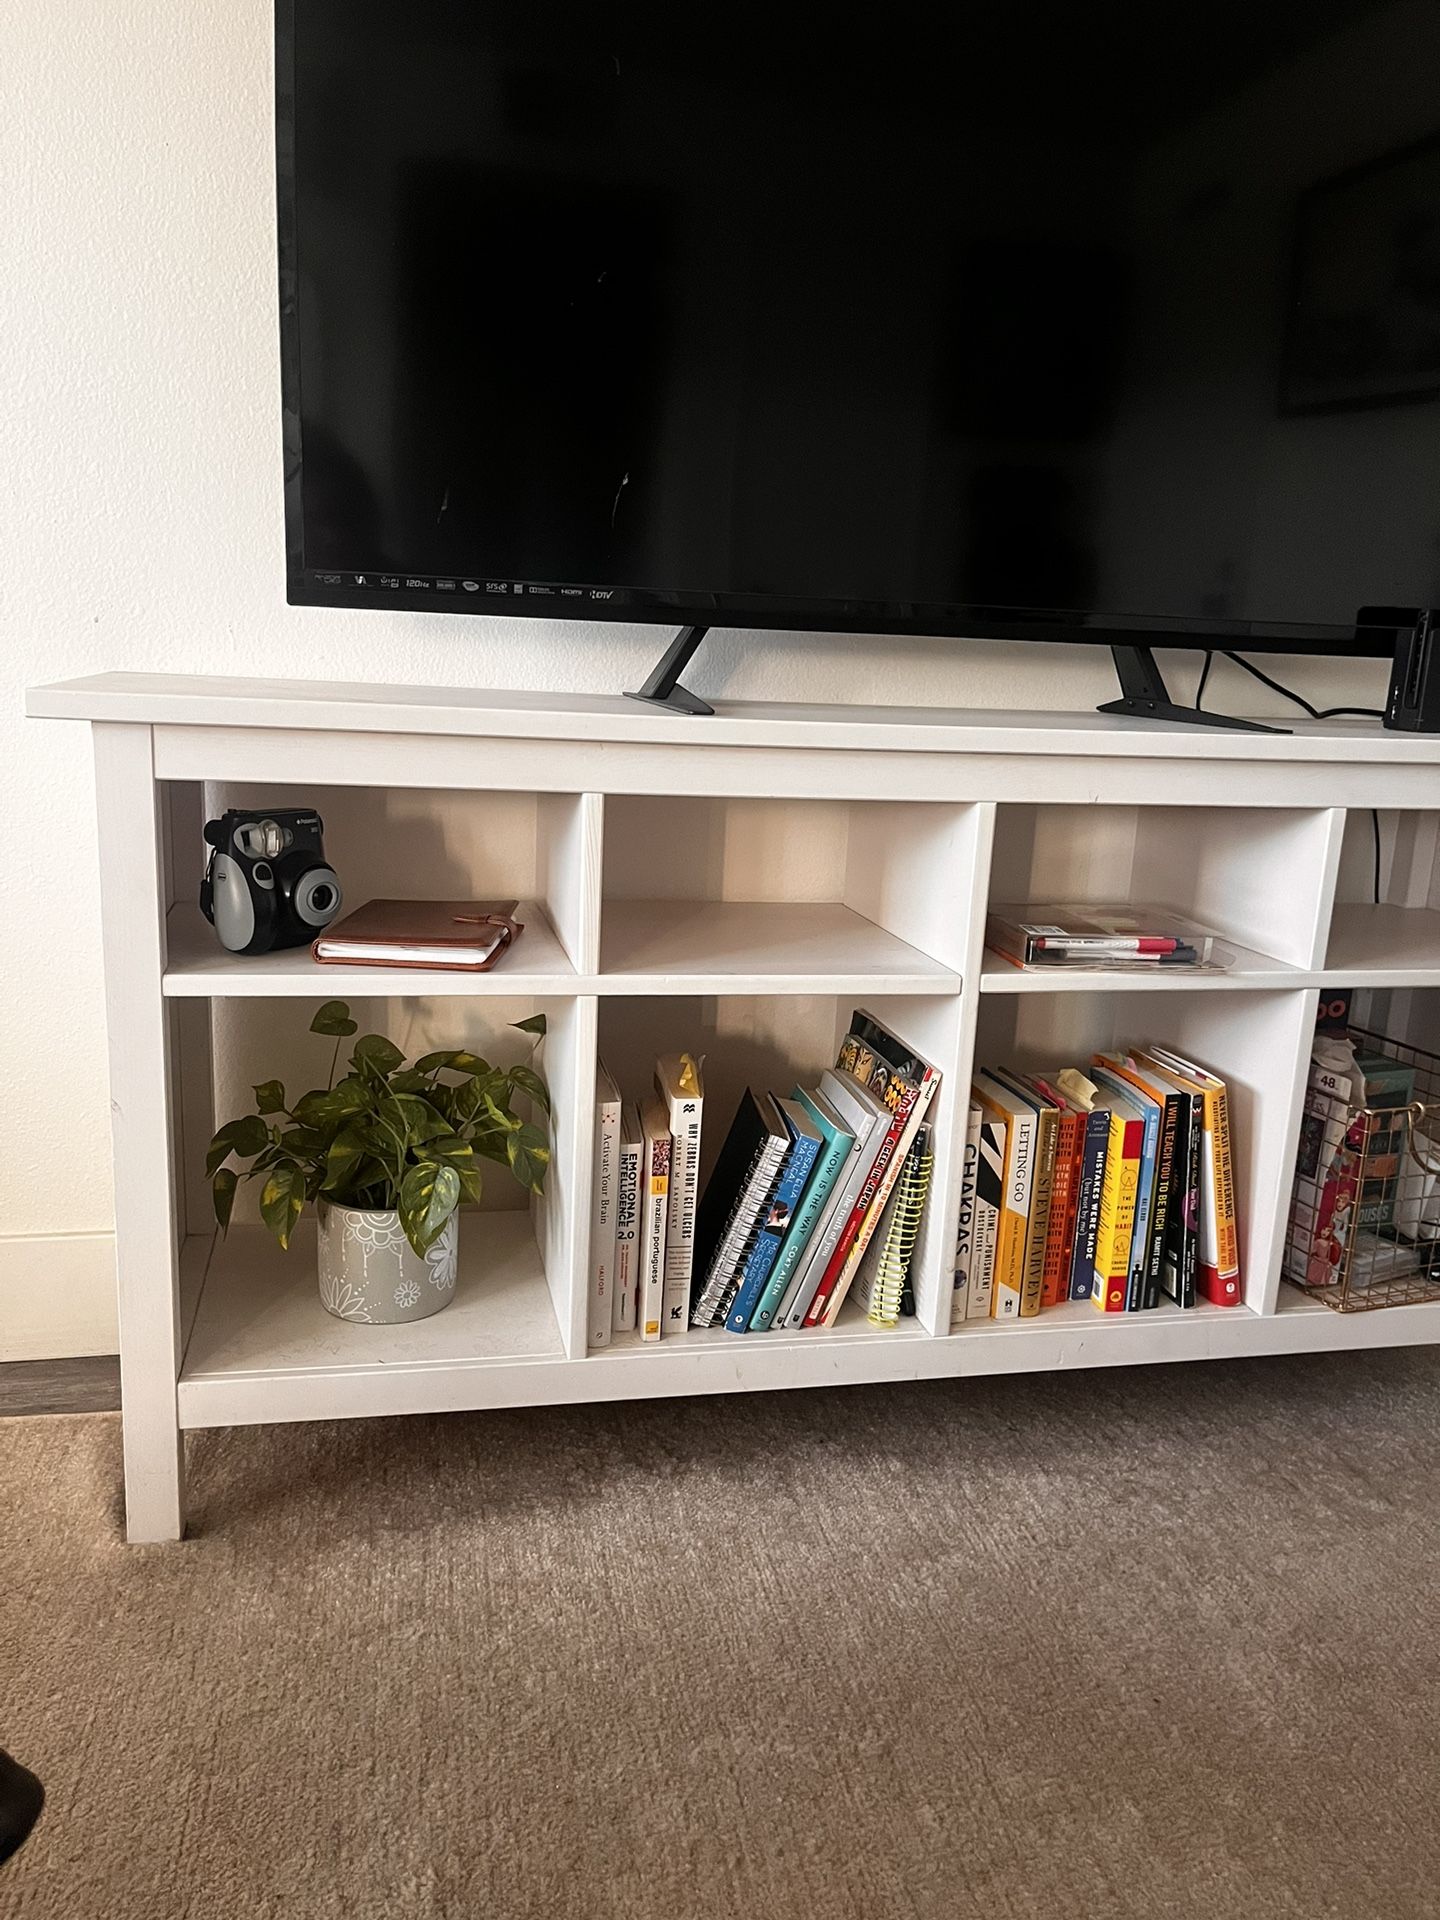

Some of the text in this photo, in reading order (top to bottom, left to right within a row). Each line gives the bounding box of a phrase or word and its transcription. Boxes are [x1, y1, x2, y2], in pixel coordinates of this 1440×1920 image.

[406, 579, 429, 588] 120Hz
[1320, 1075, 1336, 1089] 48
[1166, 1106, 1178, 1129] WILL
[675, 1134, 683, 1167] ROBERT
[876, 1146, 892, 1169] GEEK
[1162, 1130, 1175, 1159] TEACH
[1218, 1095, 1233, 1219] NEVER SPLIT THE DIFFERENCE
[799, 1144, 818, 1176] SUSAN
[825, 1150, 841, 1177] NOW
[871, 1168, 882, 1181] IN
[890, 1154, 905, 1182] SPANISH
[1014, 1123, 1030, 1202] LETTING GO
[1160, 1160, 1171, 1179] YOU
[600, 1133, 612, 1225] Activate Your Brain
[618, 1153, 629, 1228] INTELLIGENCE
[626, 1153, 638, 1228] EMOTIONAL
[682, 1123, 698, 1239] WHY ZEBRAS DON'T GET ULCERS
[818, 1180, 828, 1191] IS
[886, 1183, 893, 1192] IN
[1158, 1180, 1168, 1193] TO
[671, 1186, 680, 1229] SAPOLSKY
[809, 1193, 822, 1210] THE
[857, 1179, 876, 1211] JAPAN
[883, 1192, 889, 1201] 10
[956, 1143, 978, 1257] CHAKRAS
[1077, 1177, 1092, 1237] (but not by me)
[1085, 1151, 1104, 1260] MISTAKES WERE MADE
[1156, 1195, 1166, 1207] BE
[654, 1197, 663, 1234] brazilian
[799, 1216, 813, 1236] WAY
[822, 1194, 854, 1257] the truth of you
[868, 1200, 884, 1230] MINUTES
[987, 1207, 996, 1232] CRIME
[1154, 1208, 1165, 1230] RICH
[859, 1238, 869, 1252] DAY
[975, 1210, 986, 1252] DOSTOEVSKY
[1026, 1178, 1049, 1299] STEVE HARVEY
[1226, 1225, 1235, 1265] CHRIS VOSS
[651, 1237, 660, 1284] portuguese
[1153, 1236, 1162, 1256] RAMIT
[981, 1244, 993, 1289] PUNISHMENT
[1150, 1257, 1159, 1276] SETHI
[772, 1270, 787, 1296] ALLEN
